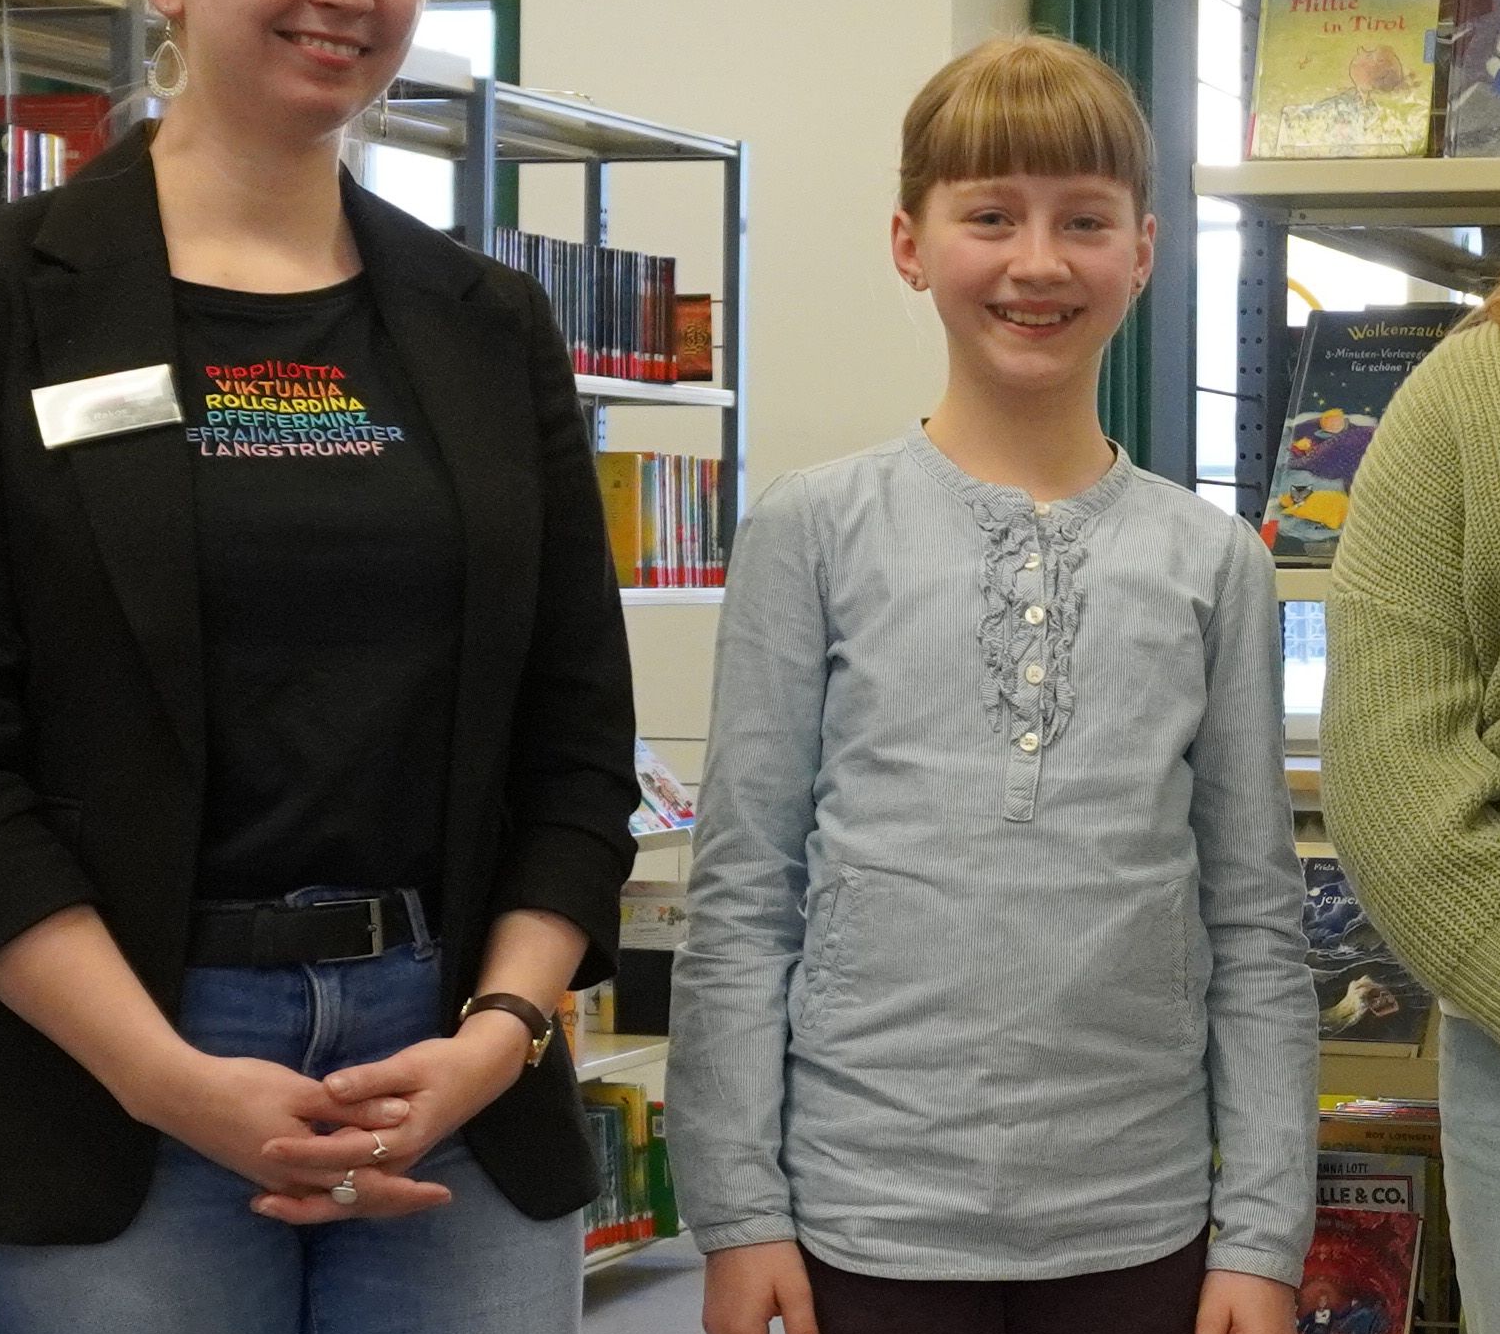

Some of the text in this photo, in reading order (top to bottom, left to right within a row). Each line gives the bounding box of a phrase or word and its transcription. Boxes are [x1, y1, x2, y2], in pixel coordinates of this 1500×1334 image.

[1323, 15, 1406, 34] in Tirol
[1347, 322, 1445, 341] Wolkenzaub
[1324, 347, 1428, 360] 3-Minuten-Vorlesege
[205, 359, 346, 381] PIPPILOTTA
[1368, 359, 1402, 372] schöne
[216, 379, 343, 398] VIKTUALIA
[205, 393, 365, 413] ROLLGARDINA
[207, 410, 371, 428] PFEFFERMINZ
[185, 425, 405, 443] EFRAIMSTOCHTER
[200, 441, 385, 457] LANGSTRUMPF
[1346, 1163, 1369, 1174] LOTT
[1316, 1187, 1406, 1205] LLE & CO.
